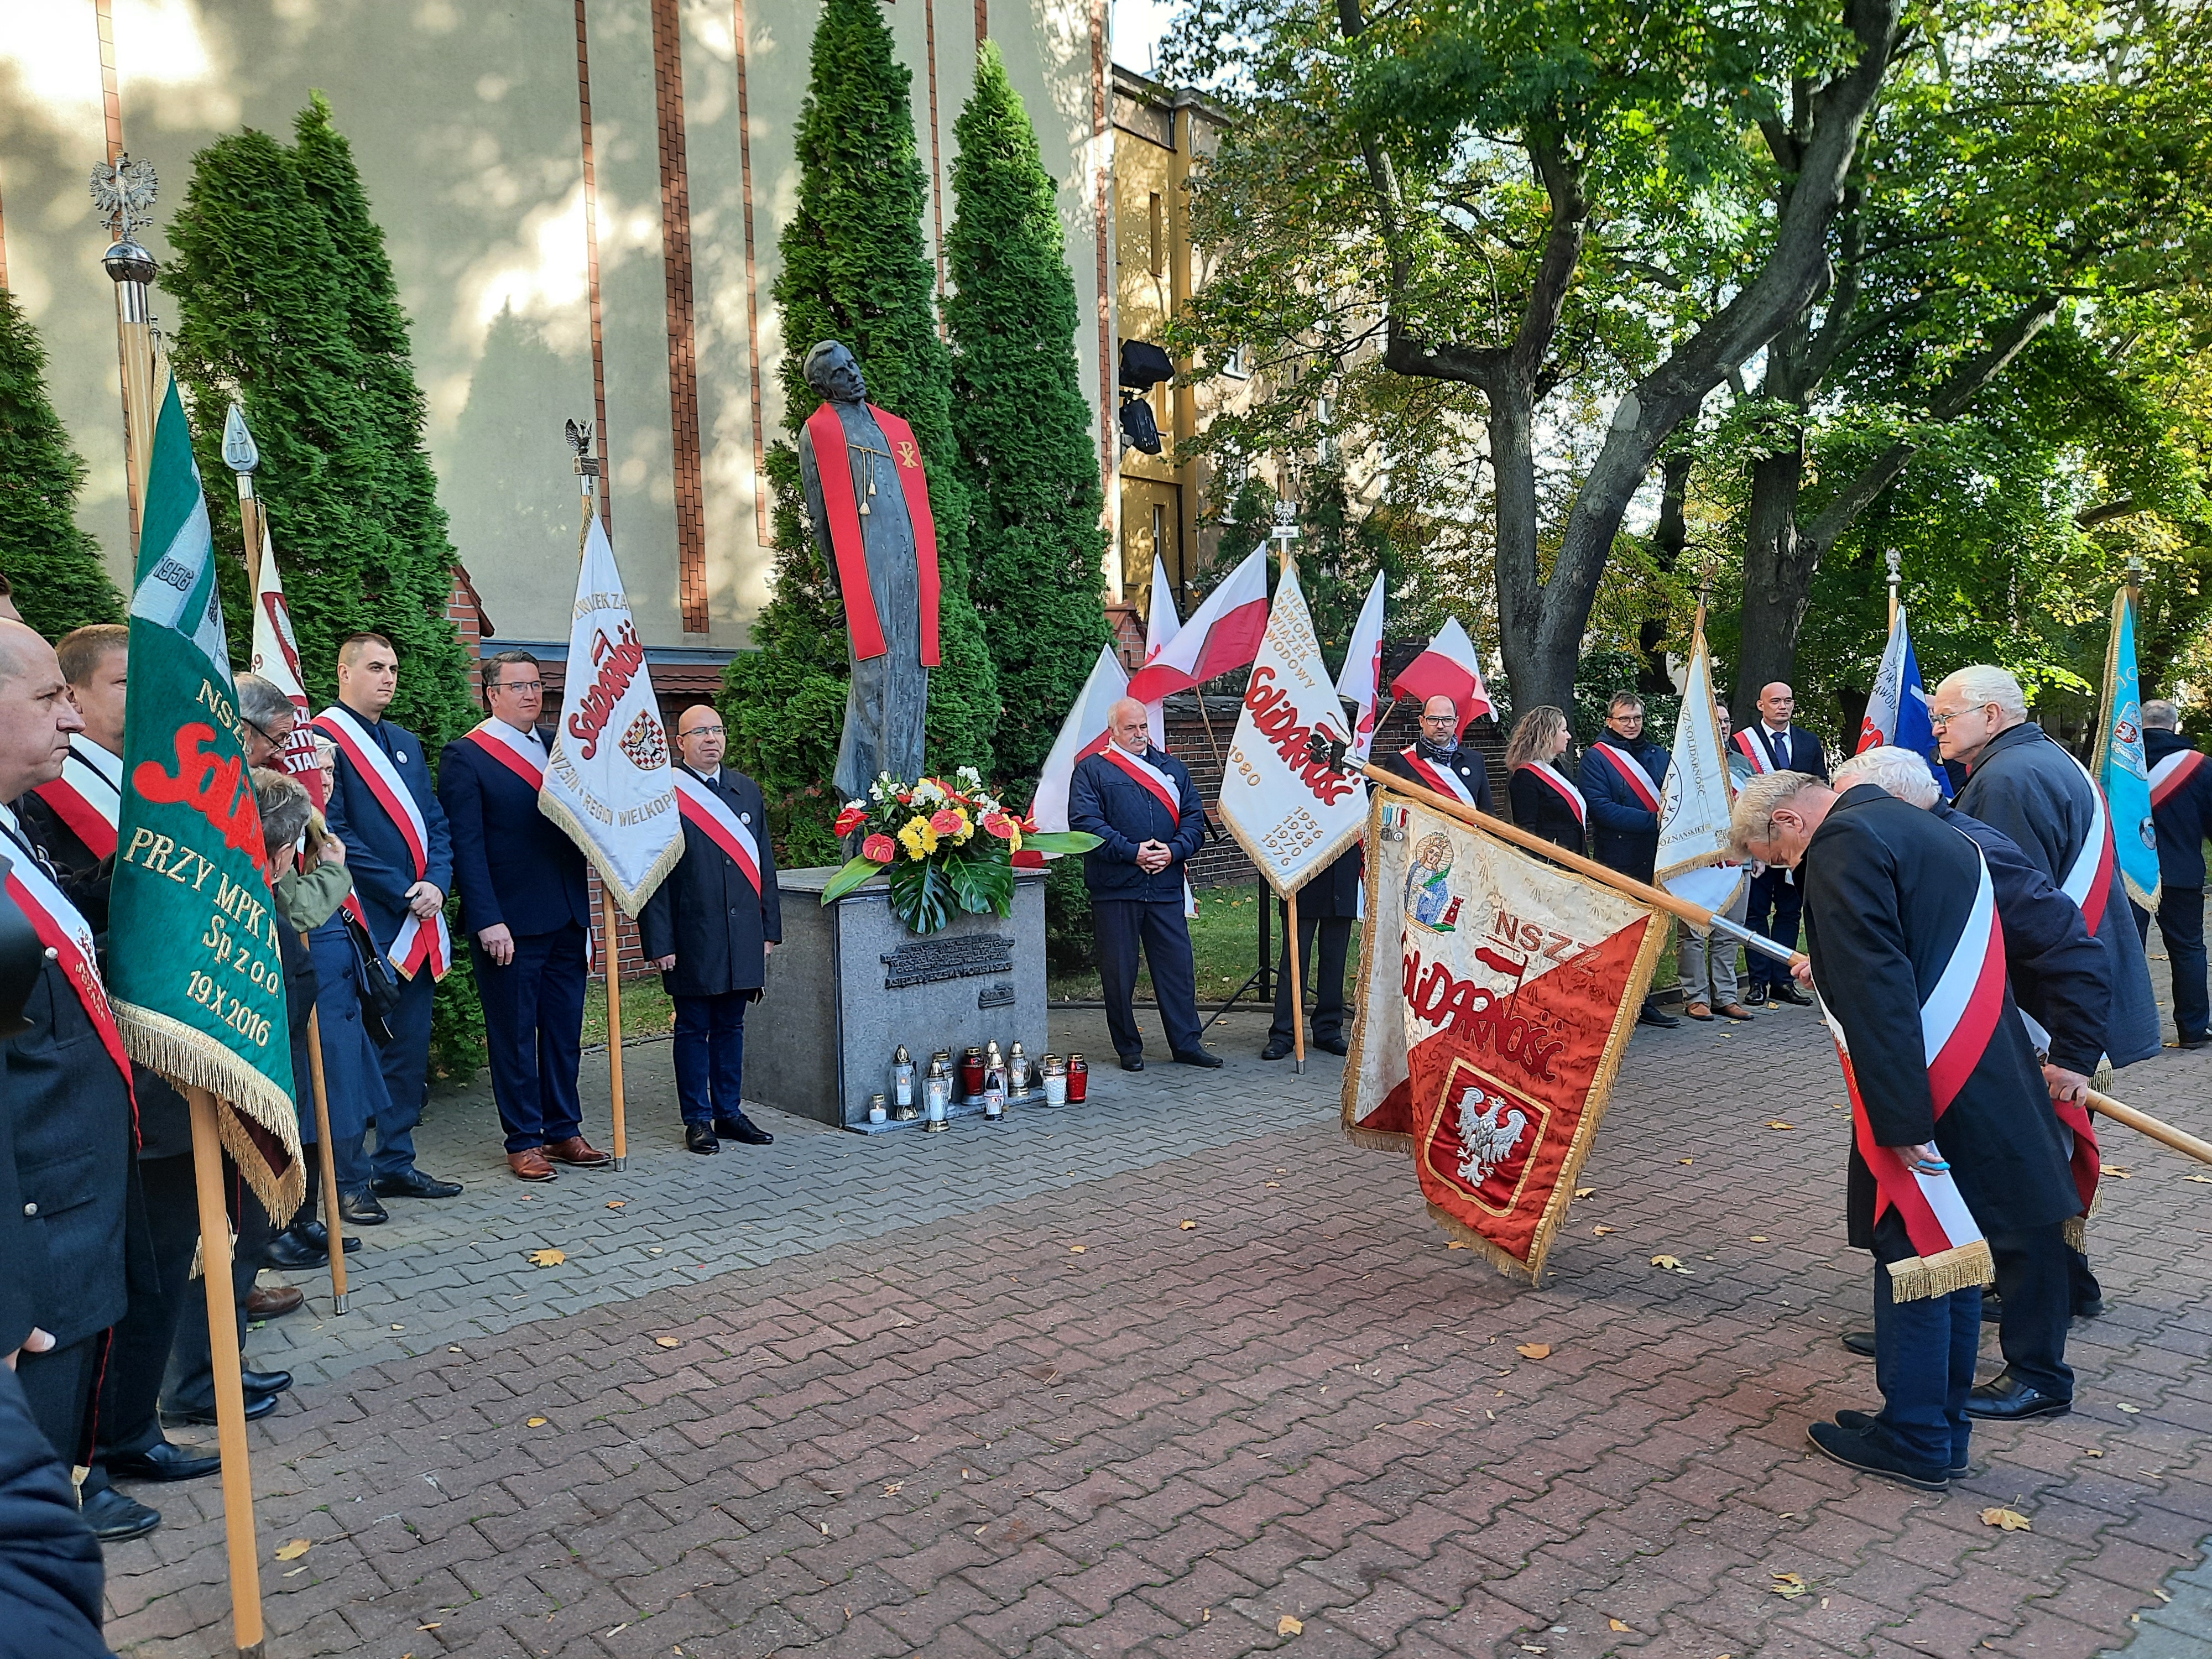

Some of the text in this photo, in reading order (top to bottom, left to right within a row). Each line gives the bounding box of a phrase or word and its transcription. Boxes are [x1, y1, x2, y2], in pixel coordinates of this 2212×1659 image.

[154, 555, 195, 591] 1956
[1282, 586, 1314, 634] NIEZA
[1228, 745, 1261, 786] 1980
[1684, 725, 1706, 797] SOLIDARNOŚĆ
[1272, 824, 1302, 857] 1970
[1282, 815, 1313, 848] 1968
[1293, 805, 1324, 839] 1956
[1261, 833, 1292, 866] 1976
[123, 827, 216, 893] PRZY
[212, 872, 267, 940] MPK
[202, 914, 232, 965] Sp.
[1494, 911, 1603, 977] NSZZ
[186, 969, 272, 1049] 19.X.2016
